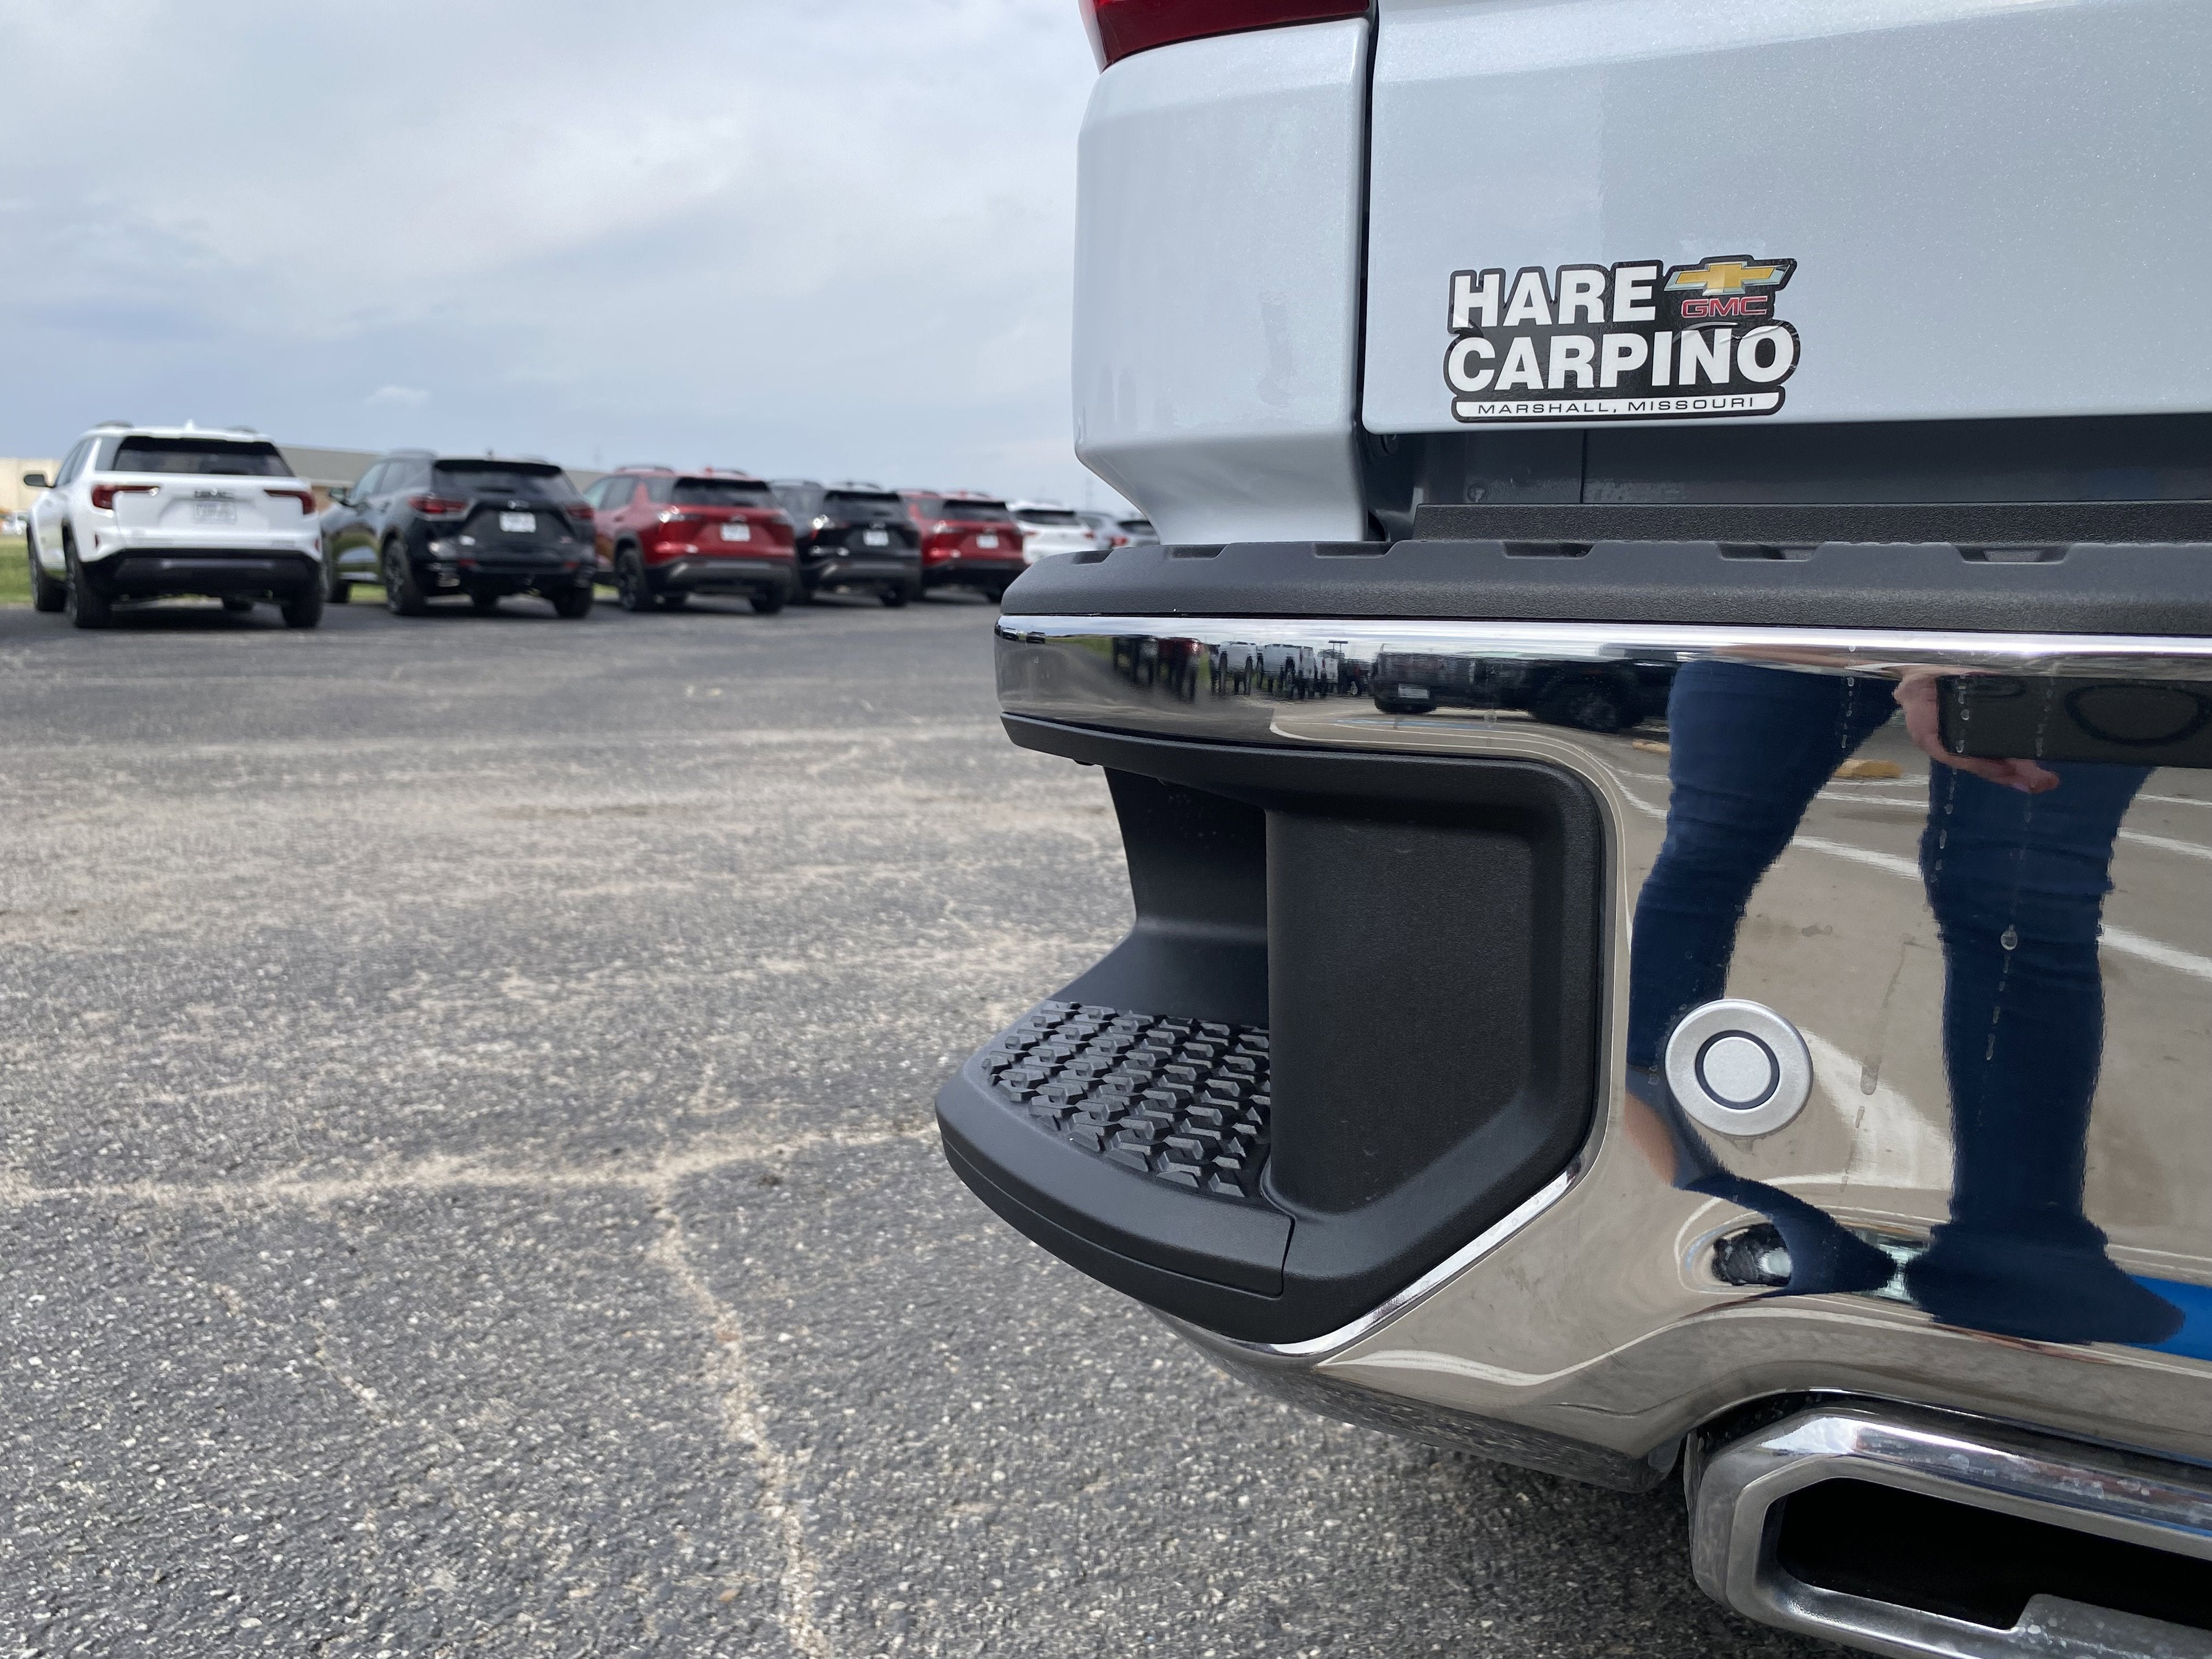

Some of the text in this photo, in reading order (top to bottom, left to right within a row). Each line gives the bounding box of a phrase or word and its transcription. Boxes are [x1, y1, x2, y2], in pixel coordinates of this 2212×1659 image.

[1452, 266, 1657, 328] HARE
[1681, 295, 1768, 318] GMC
[1448, 325, 1795, 392] CARPINO
[1477, 397, 1754, 415] MARSHALL, MISSOURI
